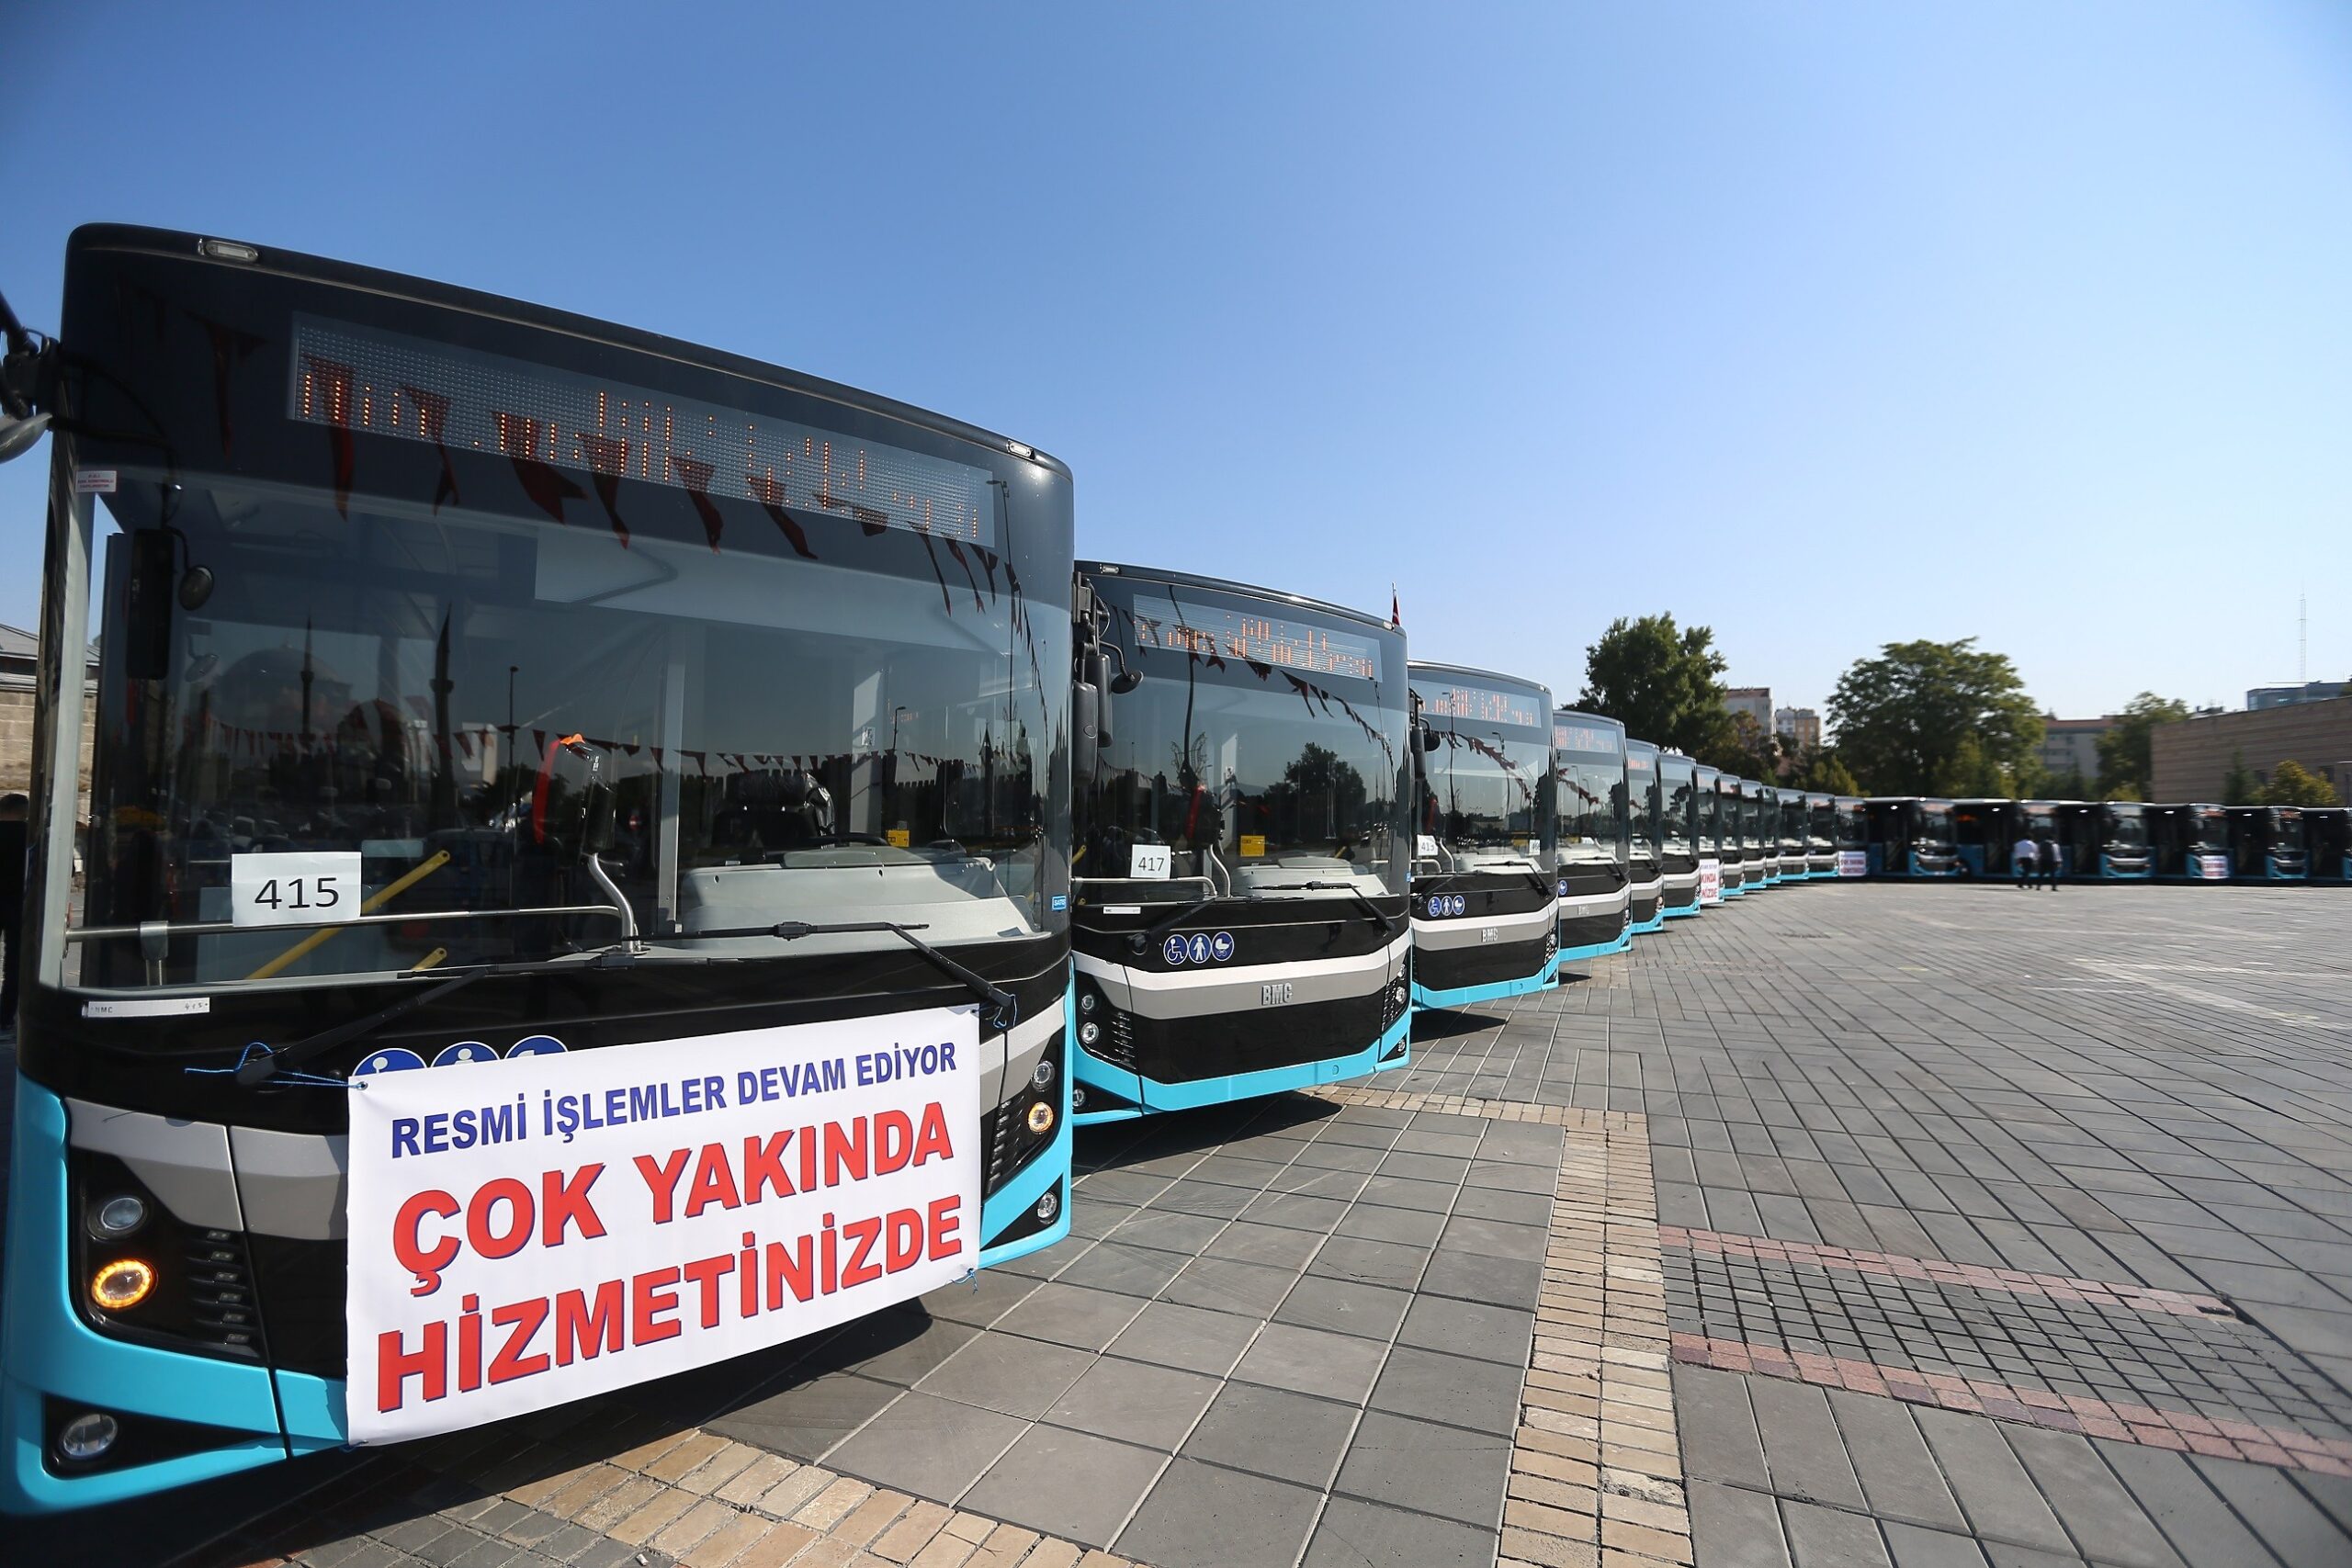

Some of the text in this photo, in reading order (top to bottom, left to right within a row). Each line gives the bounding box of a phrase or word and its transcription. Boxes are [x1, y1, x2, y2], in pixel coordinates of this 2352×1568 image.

[254, 876, 340, 910] 415
[1138, 856, 1165, 872] 417
[1261, 982, 1293, 1006] BMC
[391, 1041, 957, 1159] RESMİ İŞLEMLER DEVAM EDİYOR
[392, 1101, 956, 1297] ÇOK YAKINDA
[377, 1194, 963, 1414] HİZMETİNİZDE
